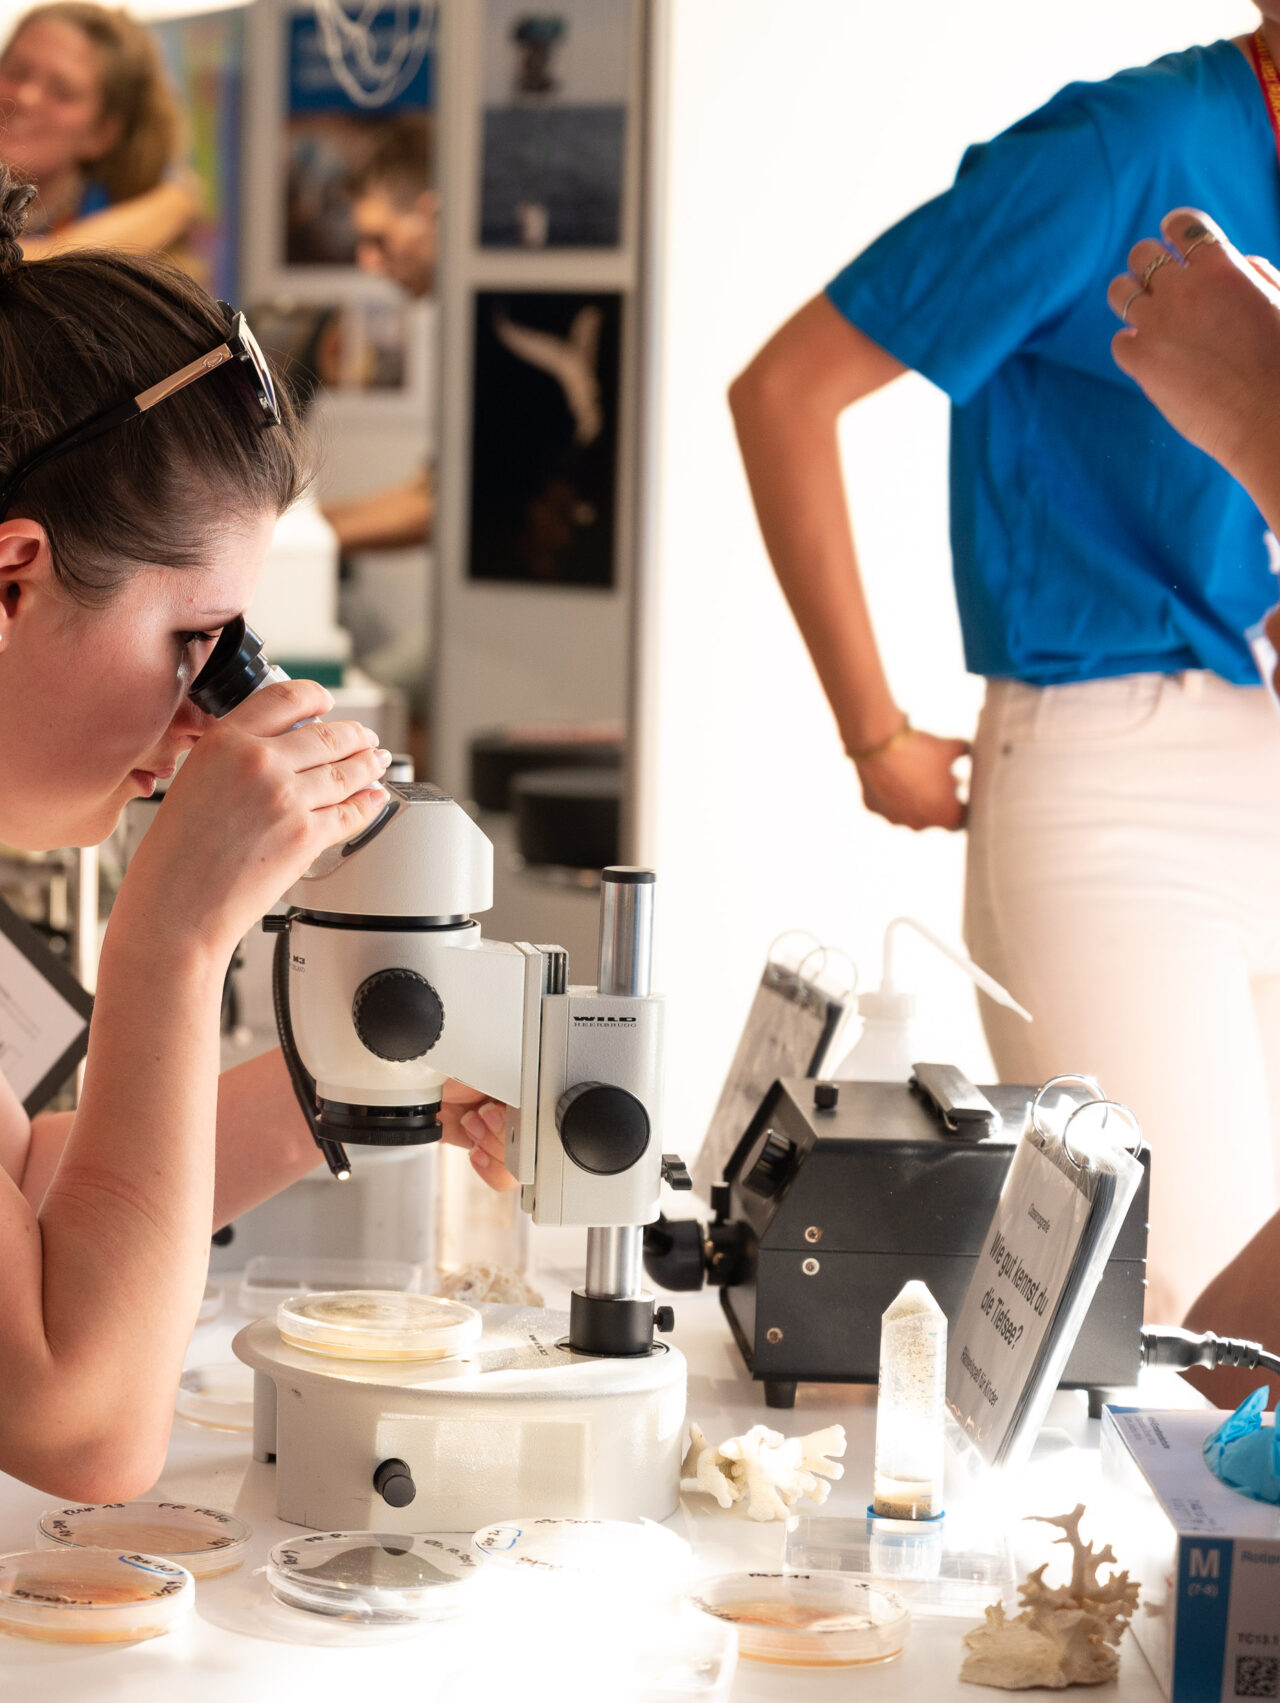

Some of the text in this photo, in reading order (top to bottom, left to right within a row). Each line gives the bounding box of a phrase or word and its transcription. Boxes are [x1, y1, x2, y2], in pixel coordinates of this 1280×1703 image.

[989, 1230, 1049, 1317] Wie gut kennst du
[980, 1287, 1024, 1350] die Tiefsee?
[977, 1373, 987, 1391] für
[982, 1380, 999, 1407] Kinder
[1188, 1548, 1220, 1578] M
